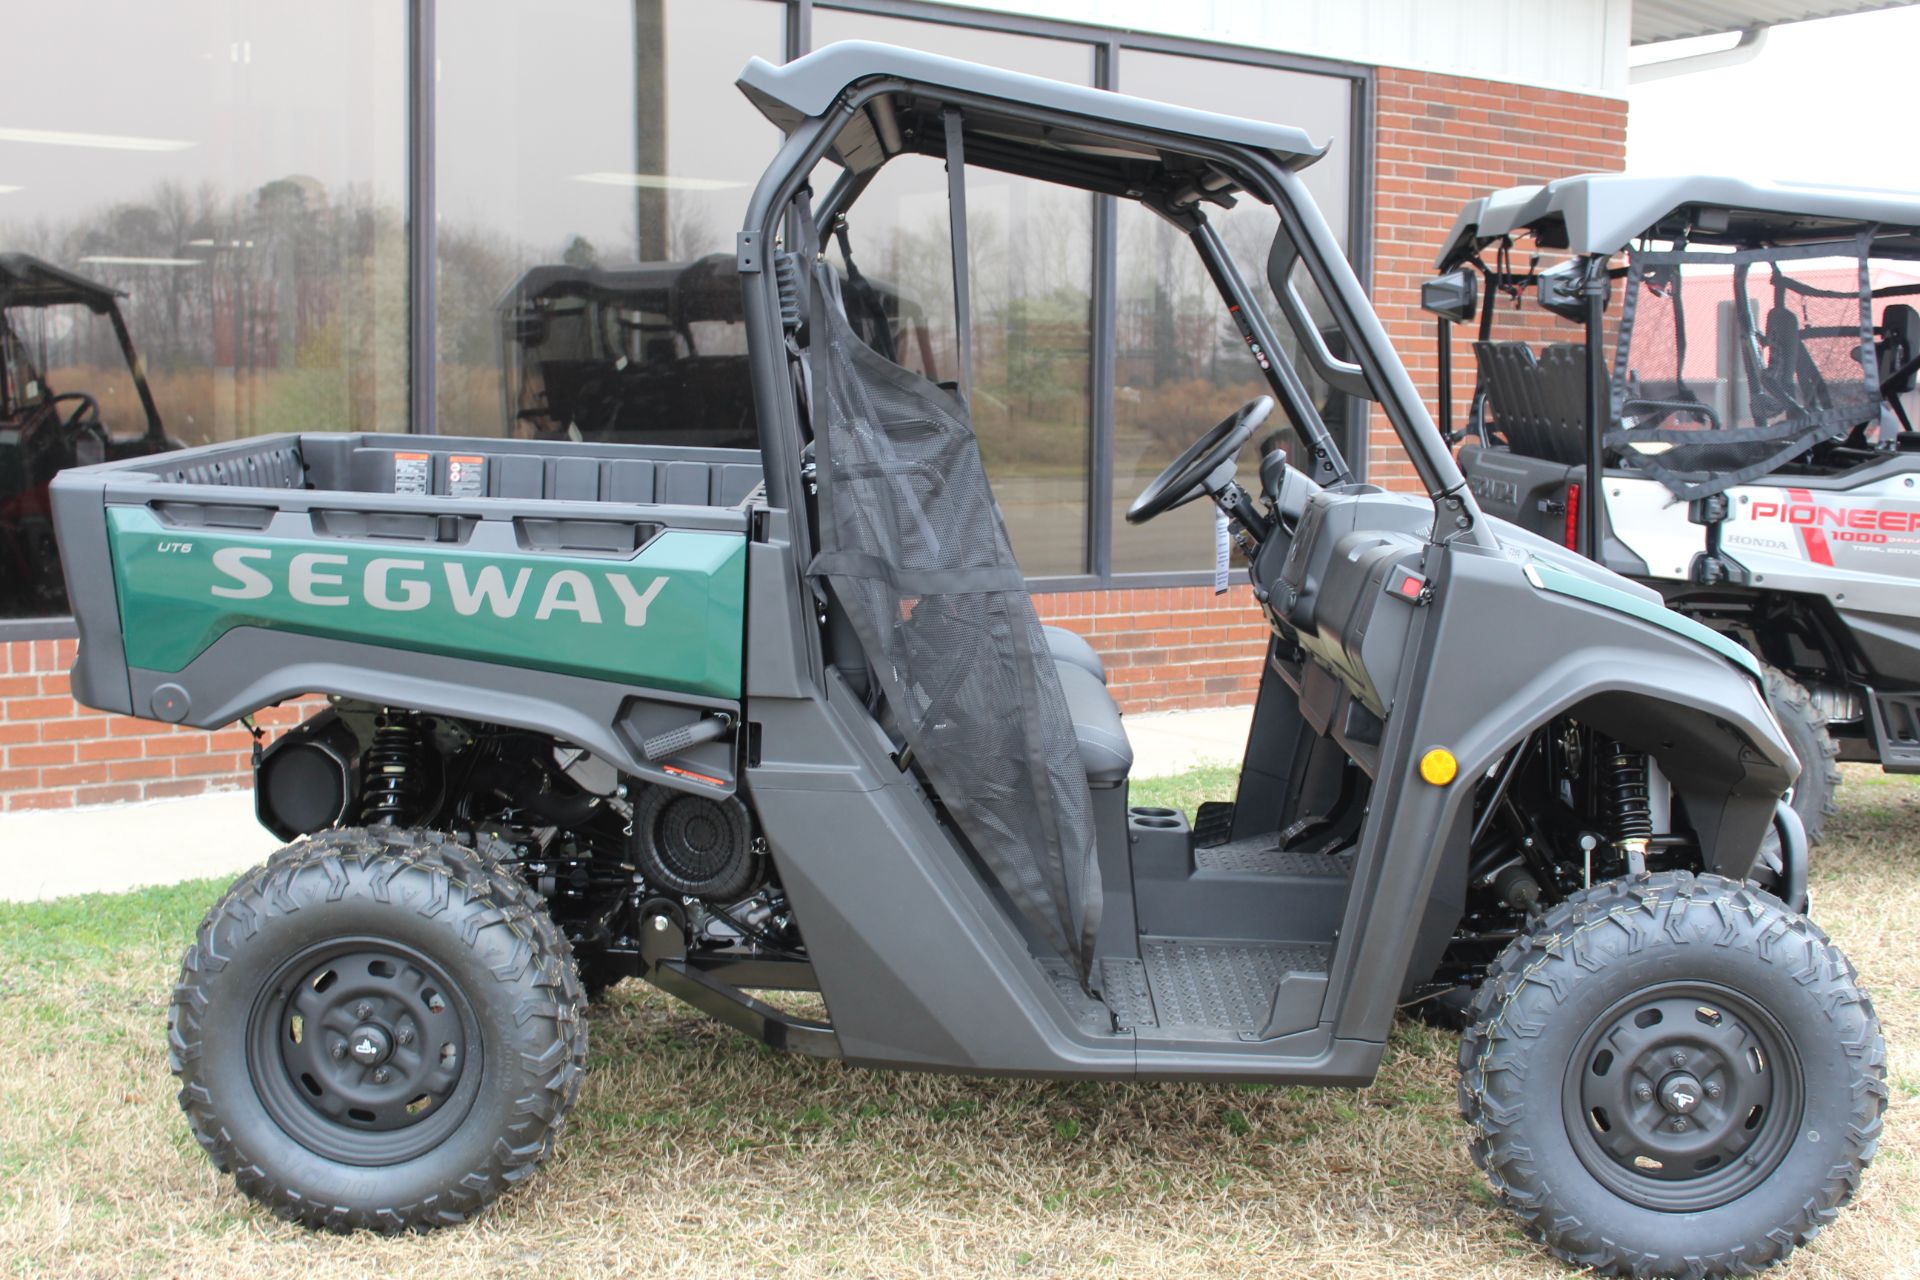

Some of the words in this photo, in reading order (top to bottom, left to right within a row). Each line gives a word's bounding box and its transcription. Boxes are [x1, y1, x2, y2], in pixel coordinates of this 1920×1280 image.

[1727, 534, 1789, 551] HONDA
[1831, 531, 1887, 544] 1000
[157, 542, 193, 553] UT6
[211, 547, 670, 627] SEGWAY
